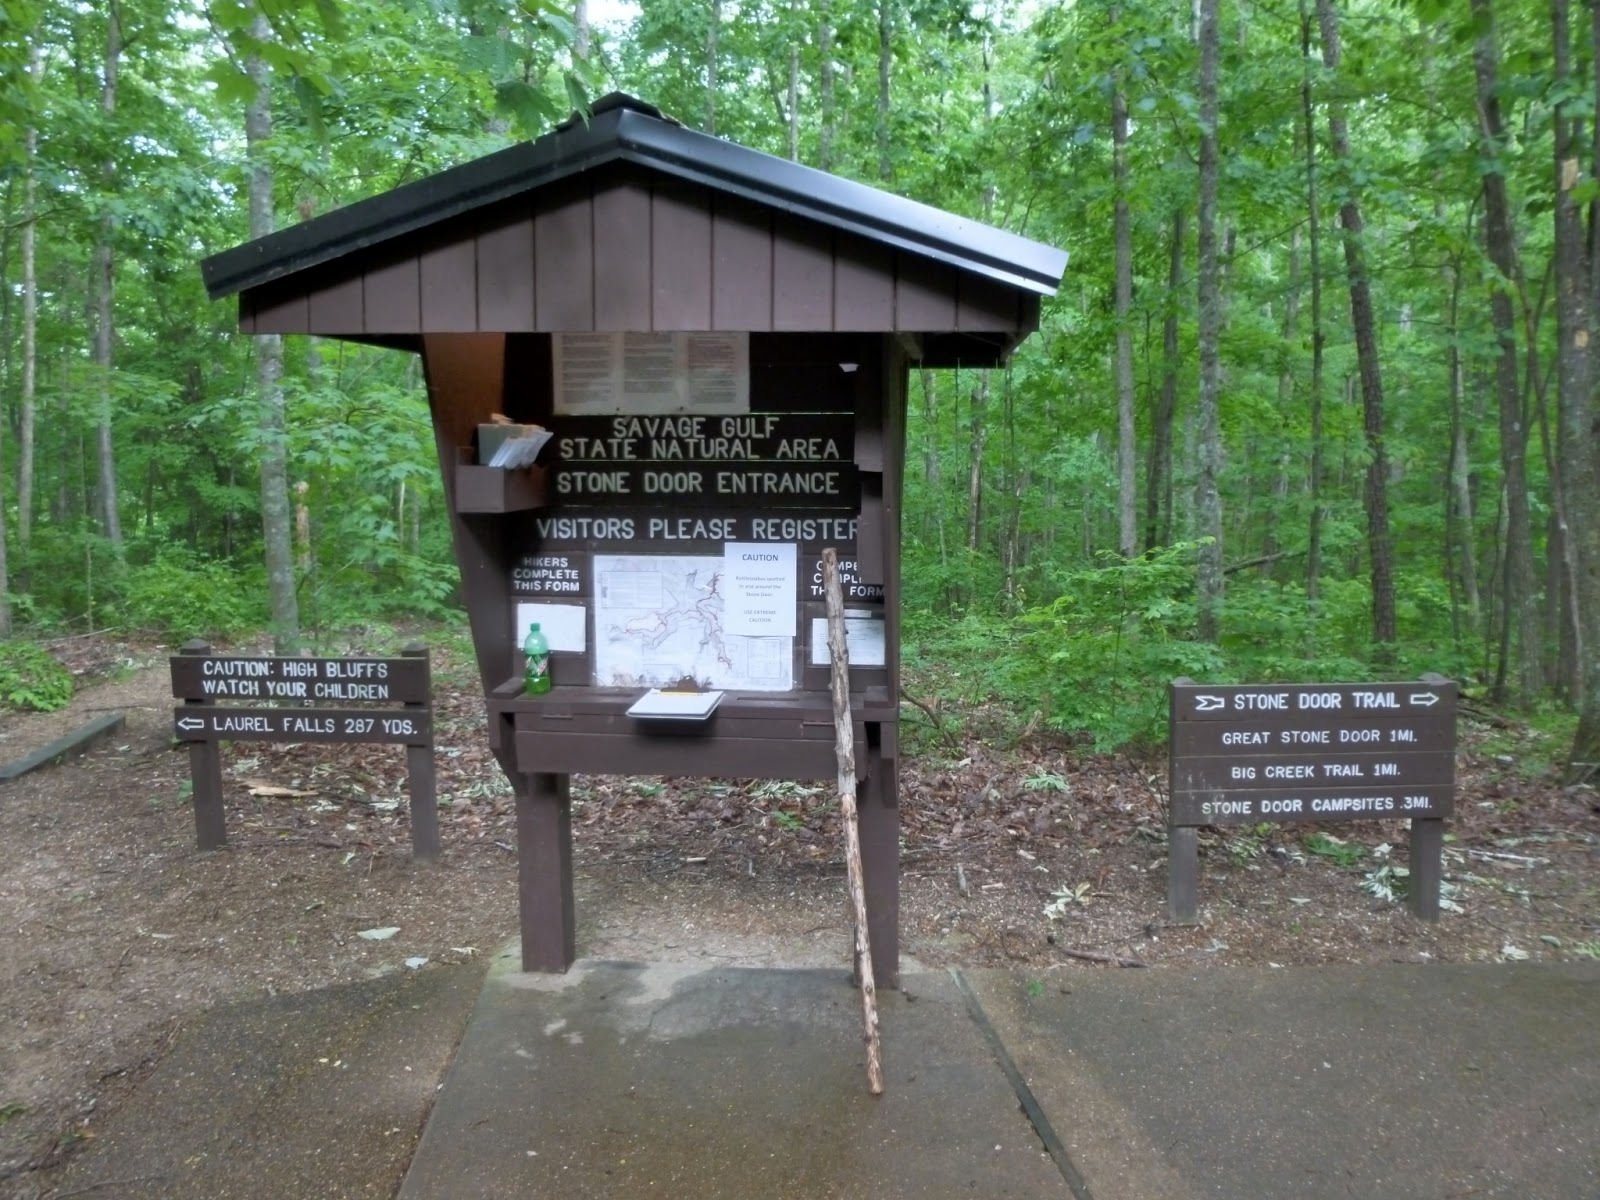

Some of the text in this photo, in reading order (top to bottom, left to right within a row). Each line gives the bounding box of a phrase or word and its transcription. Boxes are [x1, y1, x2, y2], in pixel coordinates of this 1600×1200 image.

[613, 417, 780, 439] SAVAGE GULF
[560, 438, 840, 460] STATE NATURAL AREA
[557, 472, 840, 494] STONE DOOR ENTRANCE
[536, 518, 635, 540] VISITORS
[650, 518, 737, 540] PLEASE
[523, 557, 568, 567] HIKERS
[816, 561, 857, 571] CMPE
[513, 568, 579, 579] COMPLETE
[514, 580, 580, 592] THIS FORM
[811, 586, 885, 596] TH FORM
[203, 661, 388, 678] CAUTION: HIGH BLUFFS
[202, 679, 389, 699] WATCH YOUR CHILDREN
[1234, 692, 1400, 710] STONE DOOR TRAIL
[213, 716, 418, 735] LAUREL FALLS 287 YDS.
[1222, 732, 1271, 745] GREAT
[1281, 731, 1330, 743] STONE
[1340, 730, 1380, 743] DOOR
[1231, 766, 1256, 779] BIG
[1265, 765, 1315, 778] CREEK
[1323, 764, 1364, 777] TRAIL
[1202, 801, 1252, 815] STONE
[1261, 800, 1302, 813] DOOR
[1311, 797, 1394, 812] CAMPSITES
